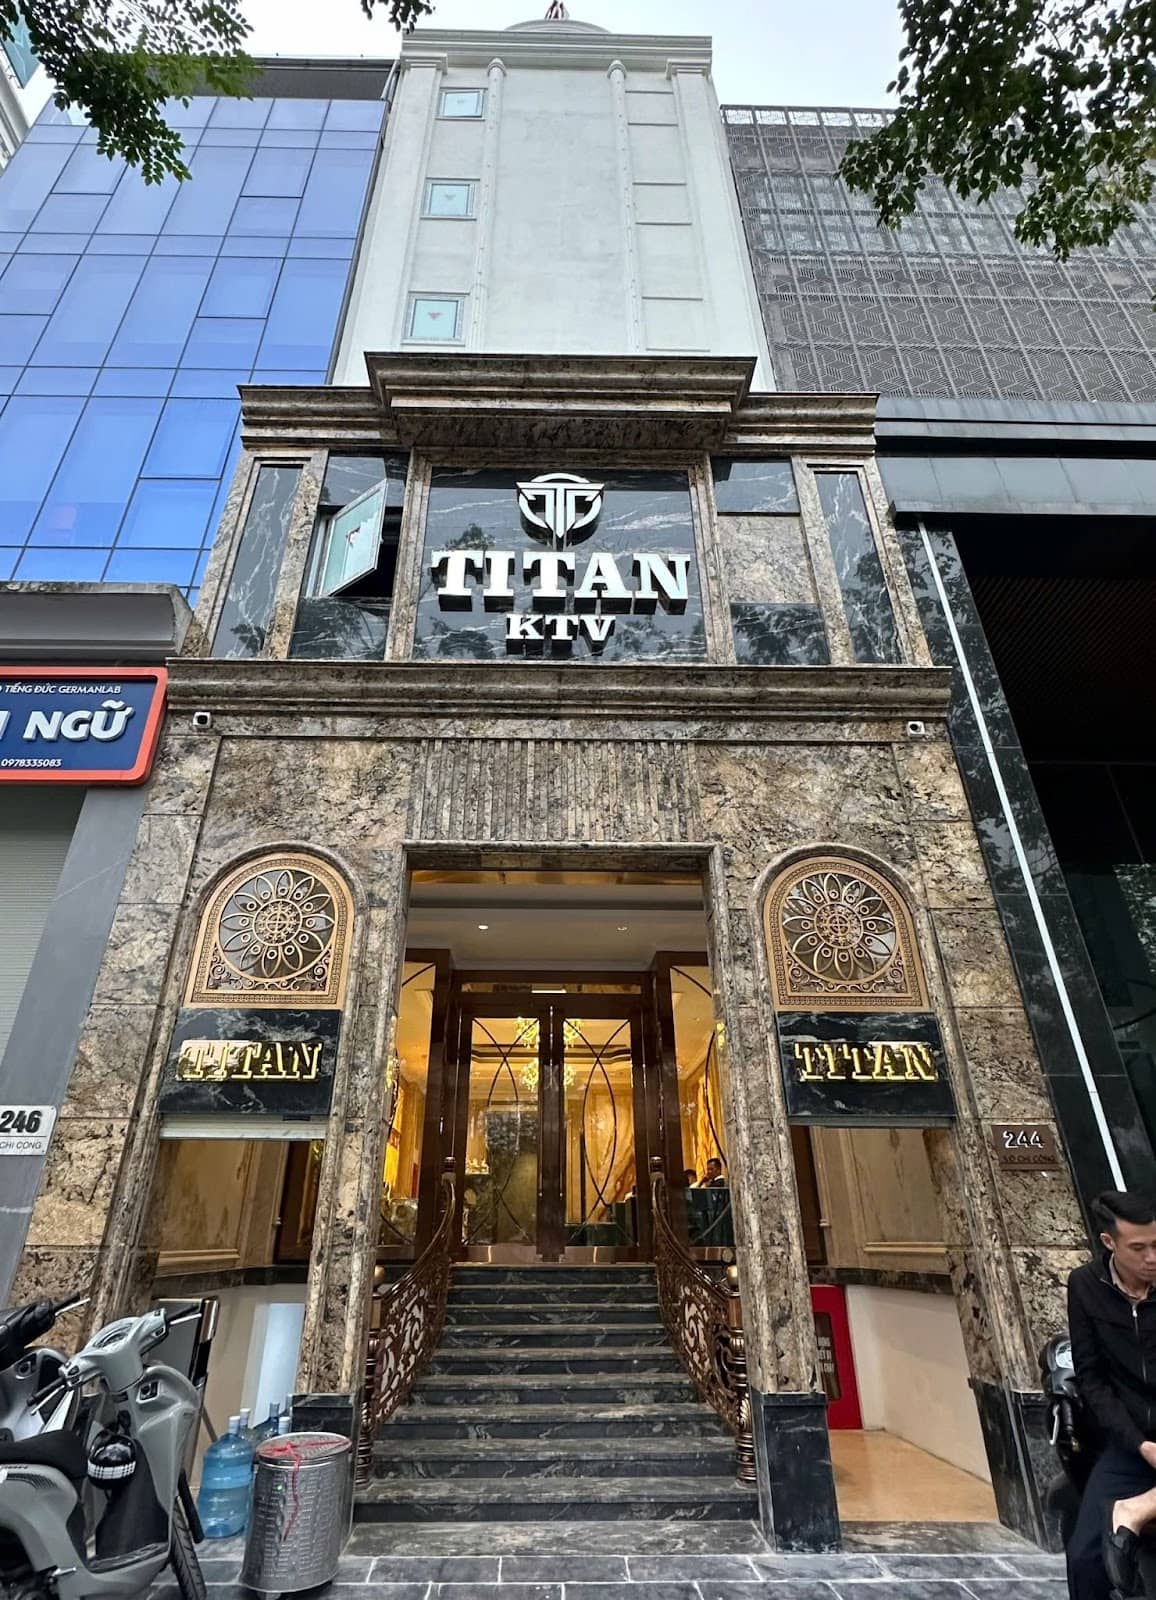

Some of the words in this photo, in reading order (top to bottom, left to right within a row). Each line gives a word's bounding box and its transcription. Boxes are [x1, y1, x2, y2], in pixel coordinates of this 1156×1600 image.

[431, 549, 691, 601] TITAN
[505, 613, 616, 642] KTV
[5, 682, 32, 694] TIẾNG
[58, 685, 122, 694] GERMANLAB
[22, 698, 135, 741] NGỮ
[181, 1041, 324, 1080] TITAN
[795, 1042, 938, 1081] TITAN
[0, 1110, 43, 1133] 246
[1002, 1130, 1044, 1149] 244
